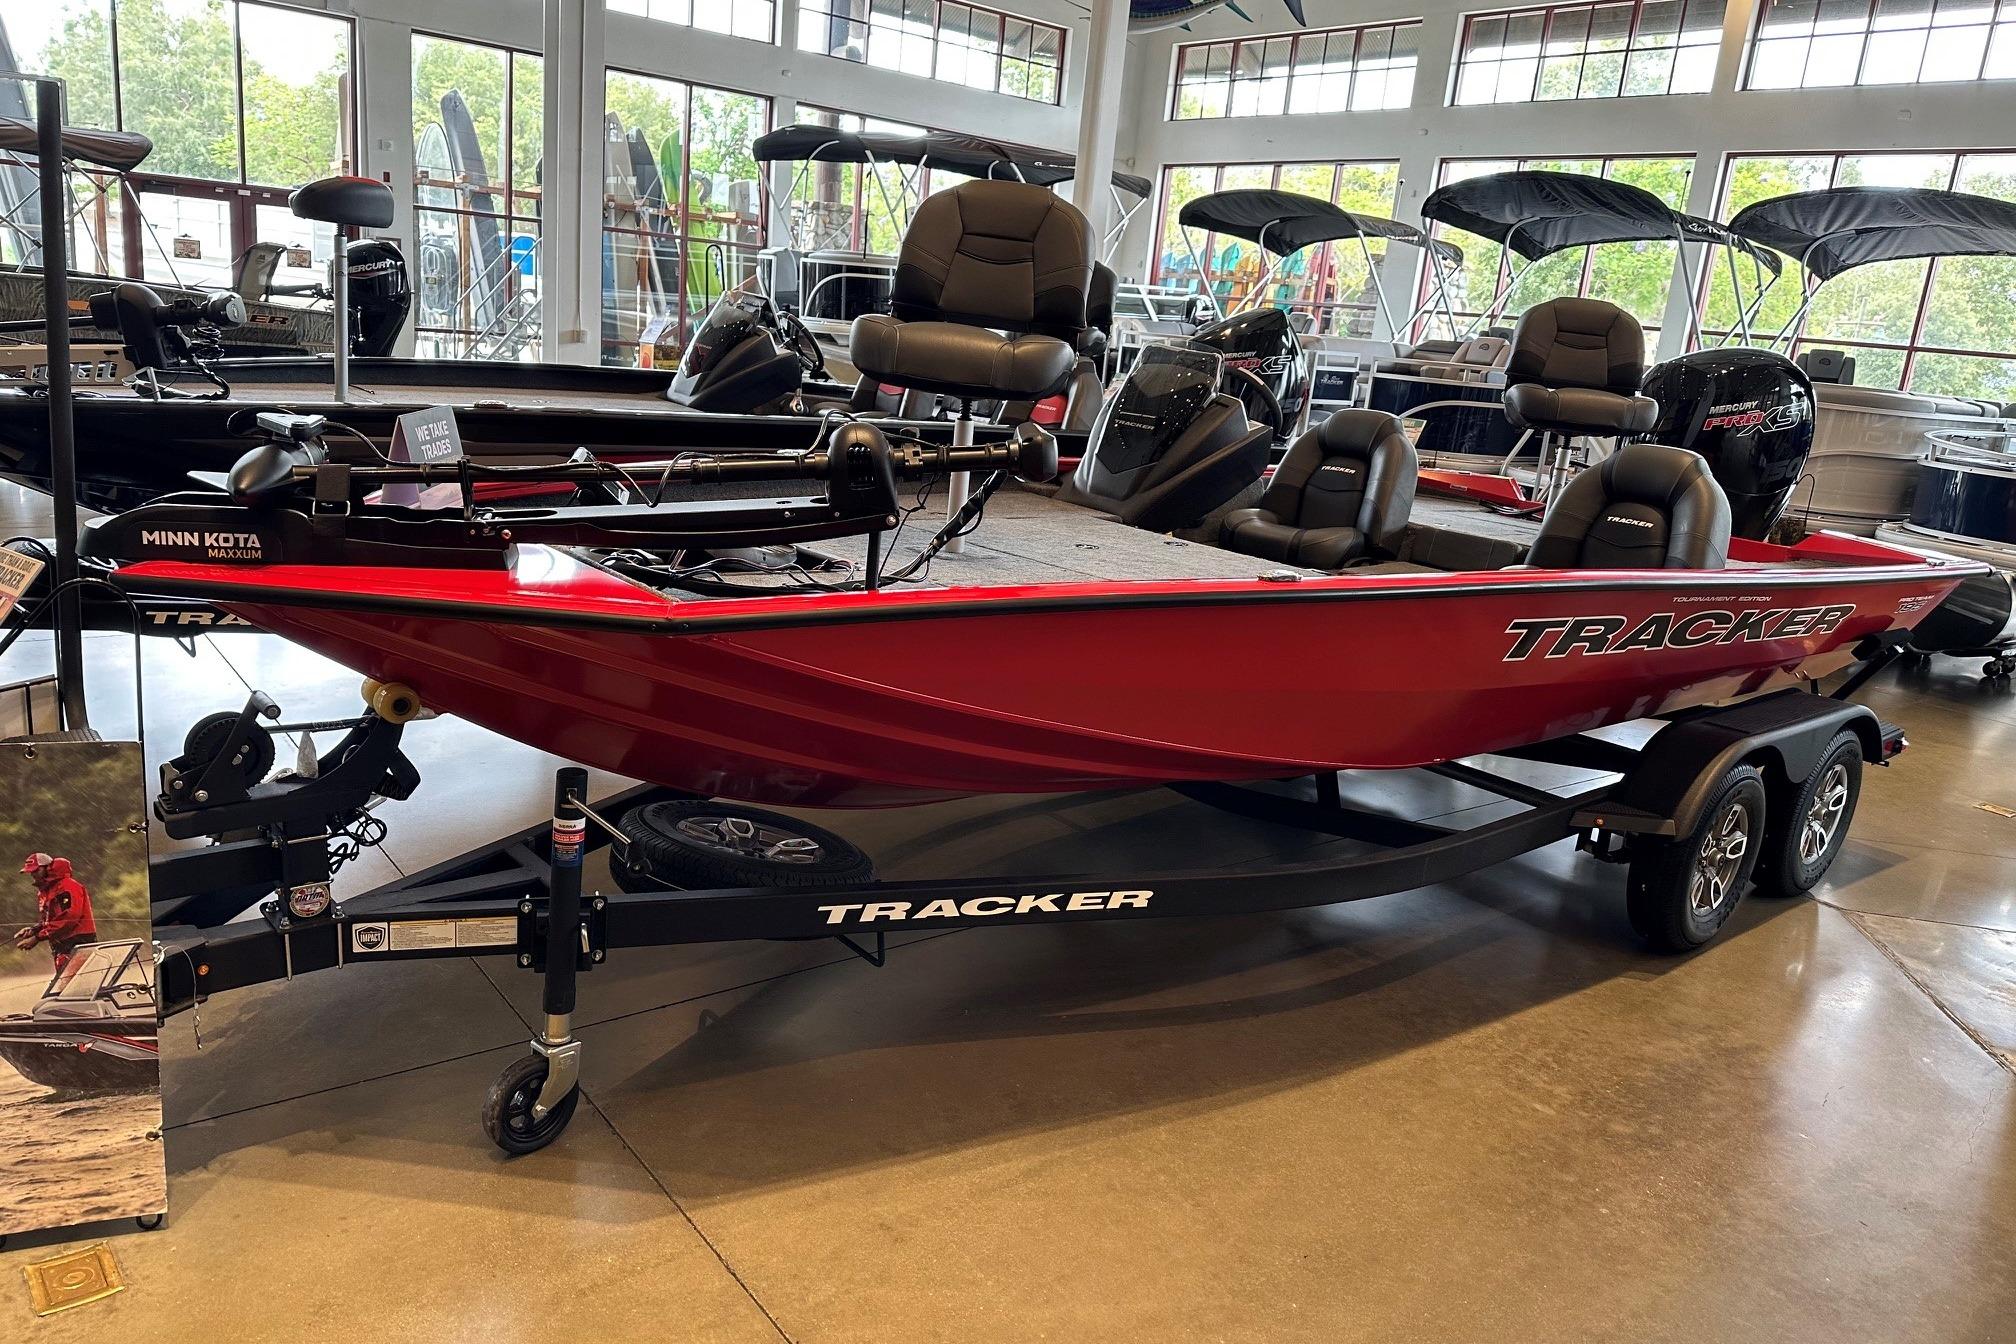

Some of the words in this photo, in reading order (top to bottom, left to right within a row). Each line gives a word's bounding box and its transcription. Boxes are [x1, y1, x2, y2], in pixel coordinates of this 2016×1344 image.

[1709, 400, 1759, 415] MERCURY
[1114, 418, 1156, 431] TRACKER
[1703, 410, 1764, 431] PRO
[1736, 402, 1804, 437] XS
[415, 425, 430, 442] WE
[429, 420, 449, 438] TAKE
[421, 438, 452, 460] TRADES
[1321, 465, 1356, 474] TRACKER
[1606, 516, 1655, 528] TRACKER
[141, 530, 199, 546] MINN
[204, 532, 262, 548] KOTA
[208, 548, 262, 559] MAXXUM
[145, 611, 253, 626] TRA
[1502, 603, 1857, 662] TRACKER
[817, 890, 1154, 924] TRACKER
[360, 932, 382, 943] IMPACT
